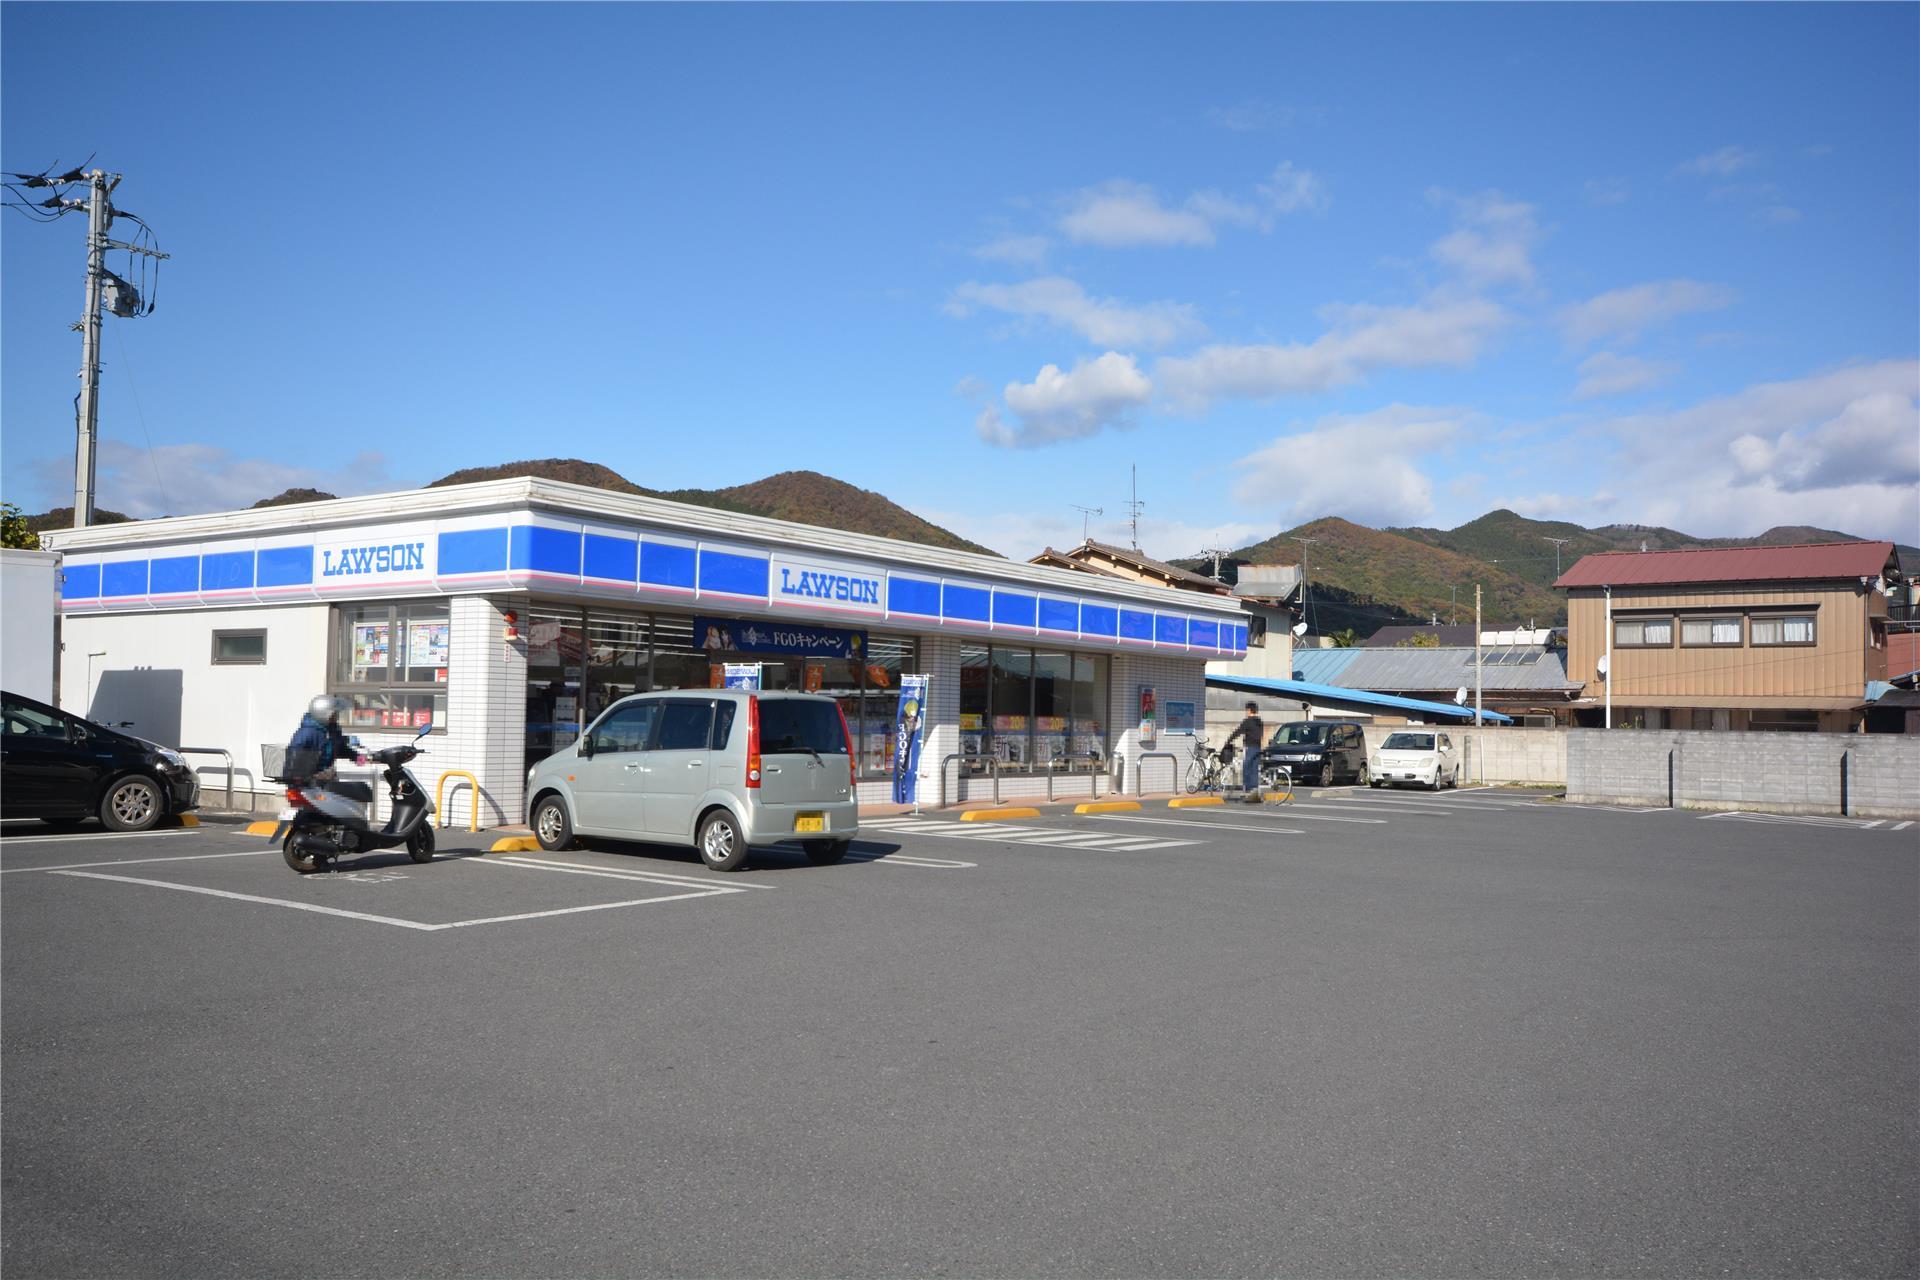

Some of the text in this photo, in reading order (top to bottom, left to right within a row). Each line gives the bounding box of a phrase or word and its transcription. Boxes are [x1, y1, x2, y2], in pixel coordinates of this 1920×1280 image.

[323, 543, 425, 576] LAWSON
[781, 568, 879, 604] LAWSON
[773, 631, 844, 649] FGOキャンペーン
